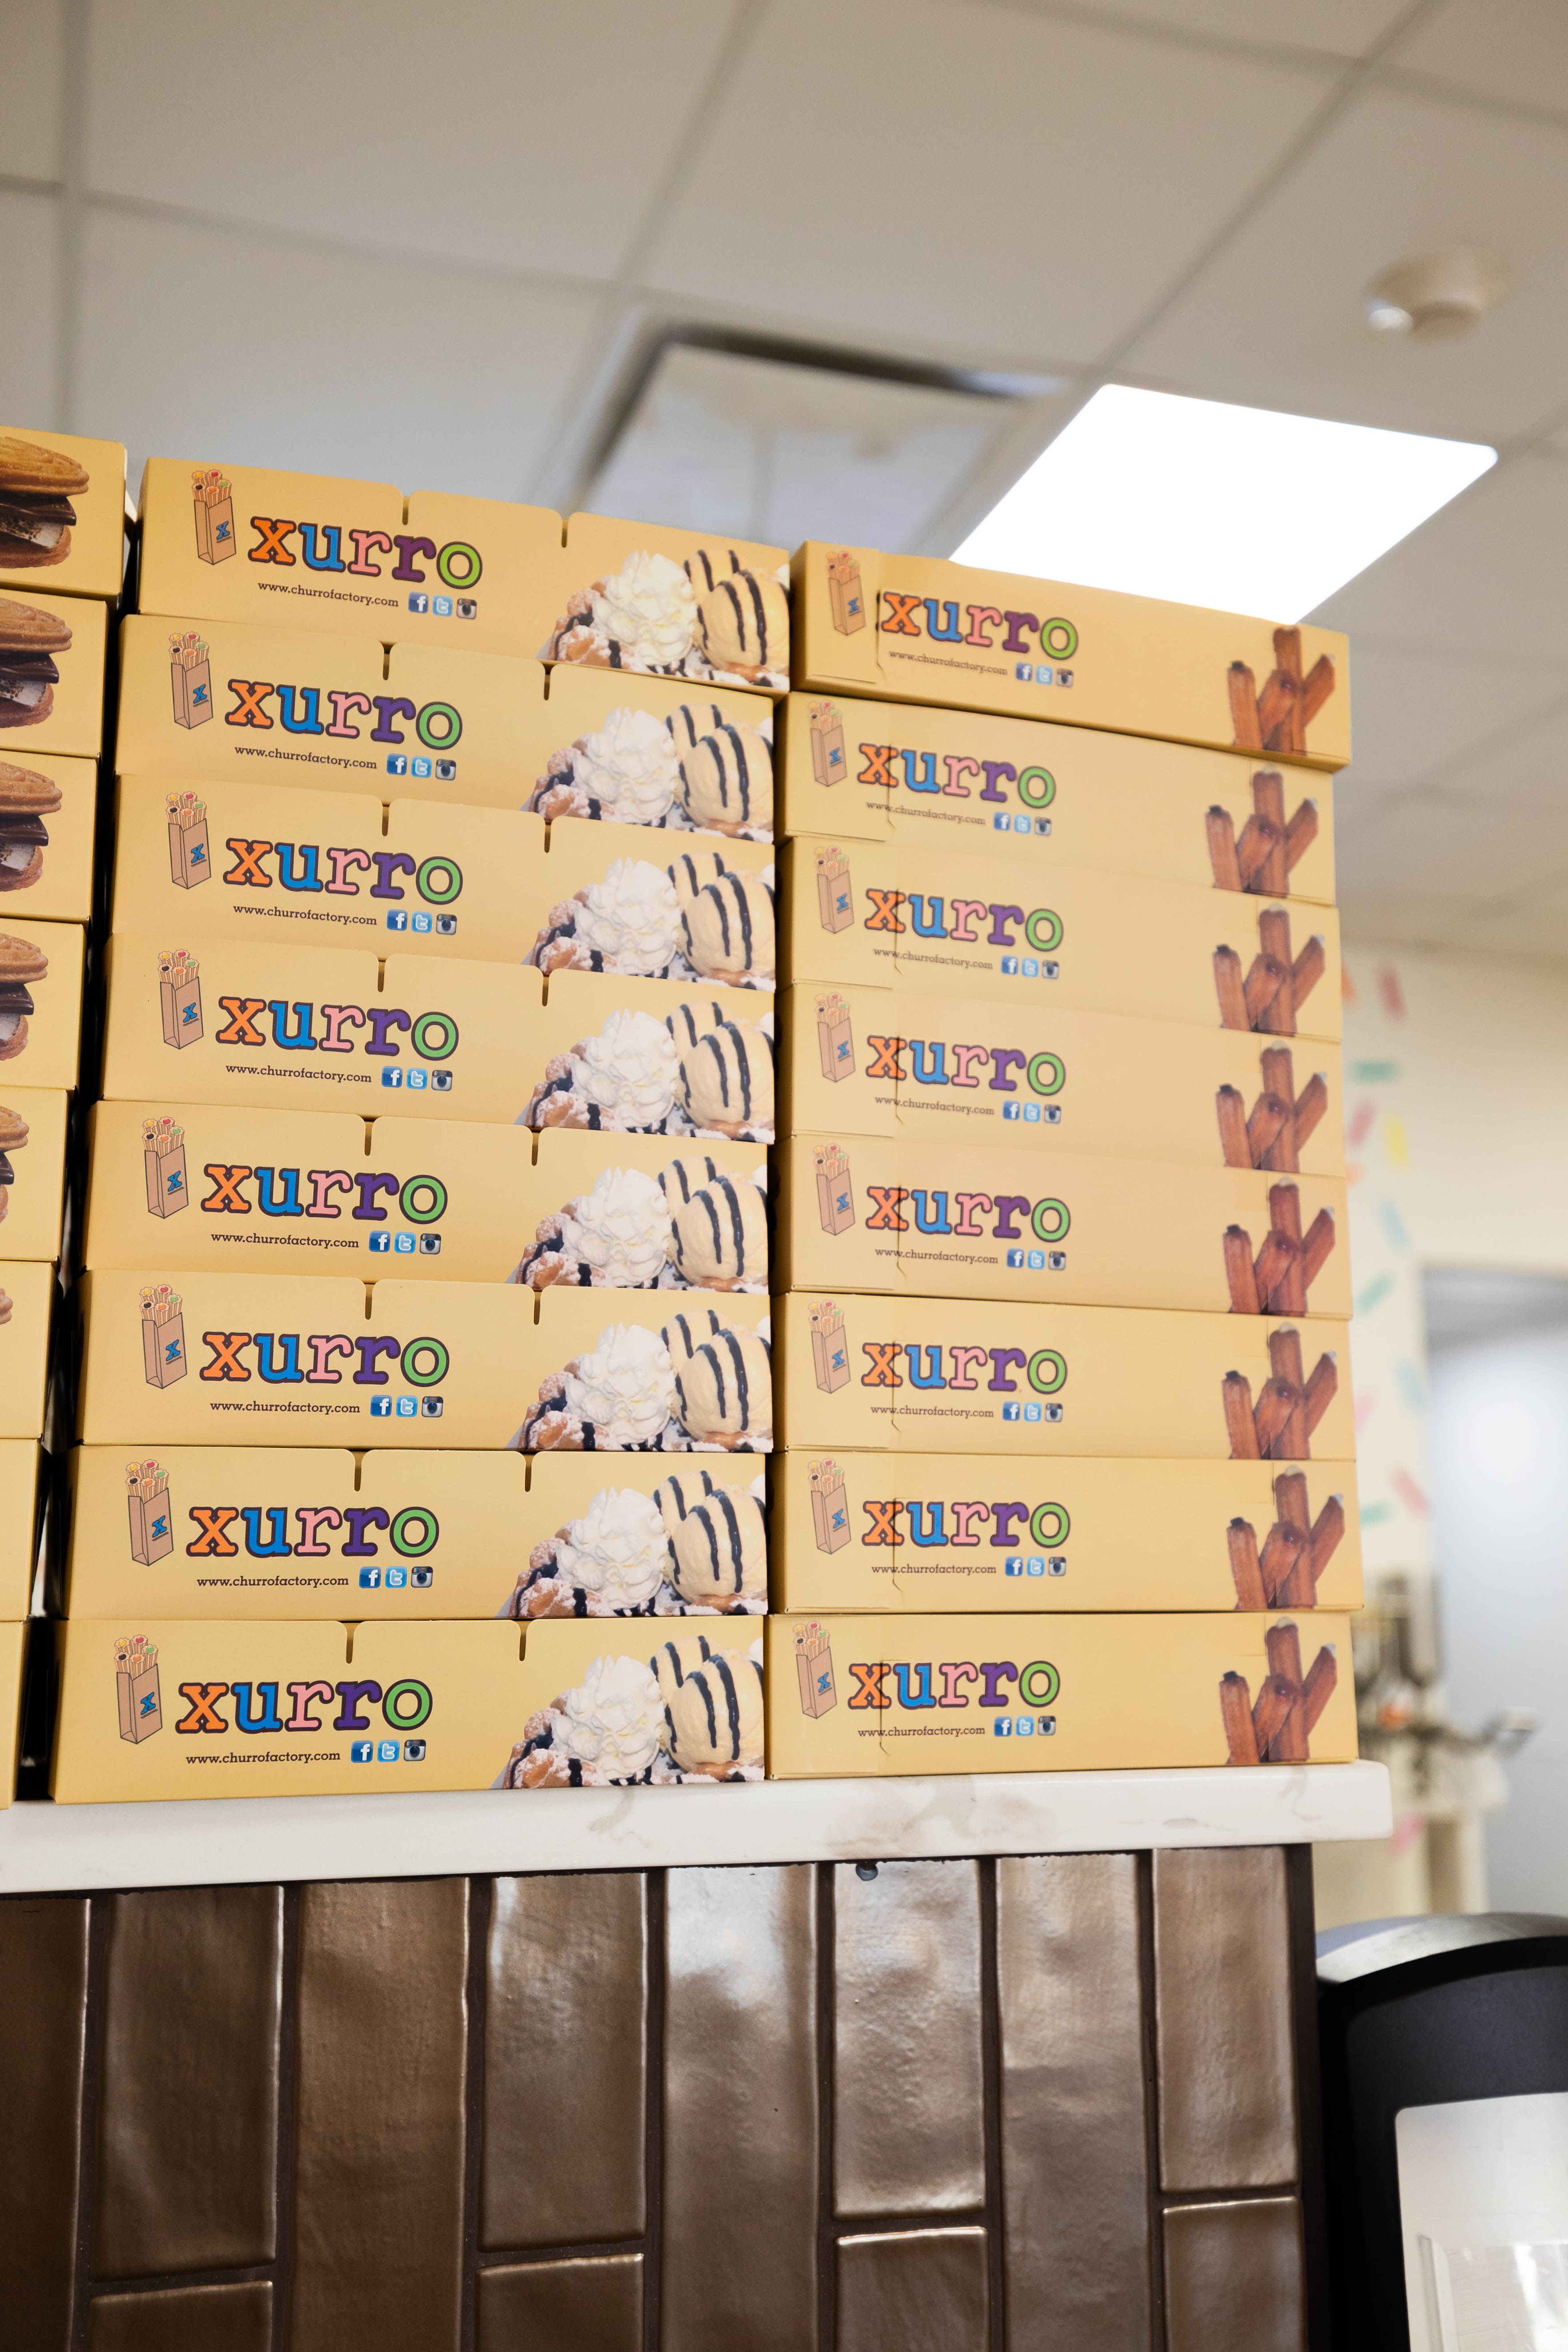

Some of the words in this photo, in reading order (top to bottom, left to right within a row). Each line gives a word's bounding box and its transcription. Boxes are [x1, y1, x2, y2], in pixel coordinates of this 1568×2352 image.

[248, 516, 483, 589] xurro
[258, 582, 399, 607] www.churrofactory.com
[881, 591, 1079, 661] xurro
[889, 649, 1008, 676] www.churrofactory.com
[225, 679, 463, 750] xurro
[235, 746, 377, 769] www.churrofactory.com
[857, 743, 1056, 809] xurro
[866, 801, 986, 826] www.churrofactory.com
[223, 837, 463, 905] xurro
[233, 905, 377, 926] www.churrofactory.com
[864, 889, 1063, 952] xurro
[873, 947, 993, 970] www.churrofactory.com
[215, 996, 459, 1061] xurro
[225, 1065, 372, 1084] www.churrofactory.com
[865, 1035, 1066, 1096] xurro
[875, 1095, 995, 1116] www.churrofactory.com
[201, 1163, 448, 1224] xurro
[865, 1186, 1071, 1243] xurro
[211, 1232, 359, 1249] www.churrofactory.com
[875, 1247, 998, 1266] www.churrofactory.com
[199, 1331, 449, 1387] xurro
[861, 1342, 1068, 1394] xurro
[210, 1401, 360, 1415] www.churrofactory.com
[870, 1405, 994, 1419] www.churrofactory.com
[186, 1507, 439, 1558] xurro
[861, 1501, 1071, 1549] xurro
[197, 1575, 349, 1588] www.churrofactory.com
[872, 1563, 997, 1576] www.churrofactory.com
[847, 1661, 1061, 1710] xurro
[175, 1679, 433, 1734] xurro
[858, 1726, 986, 1739] www.churrofactory.com
[185, 1751, 341, 1764] www.churrofactory.com
